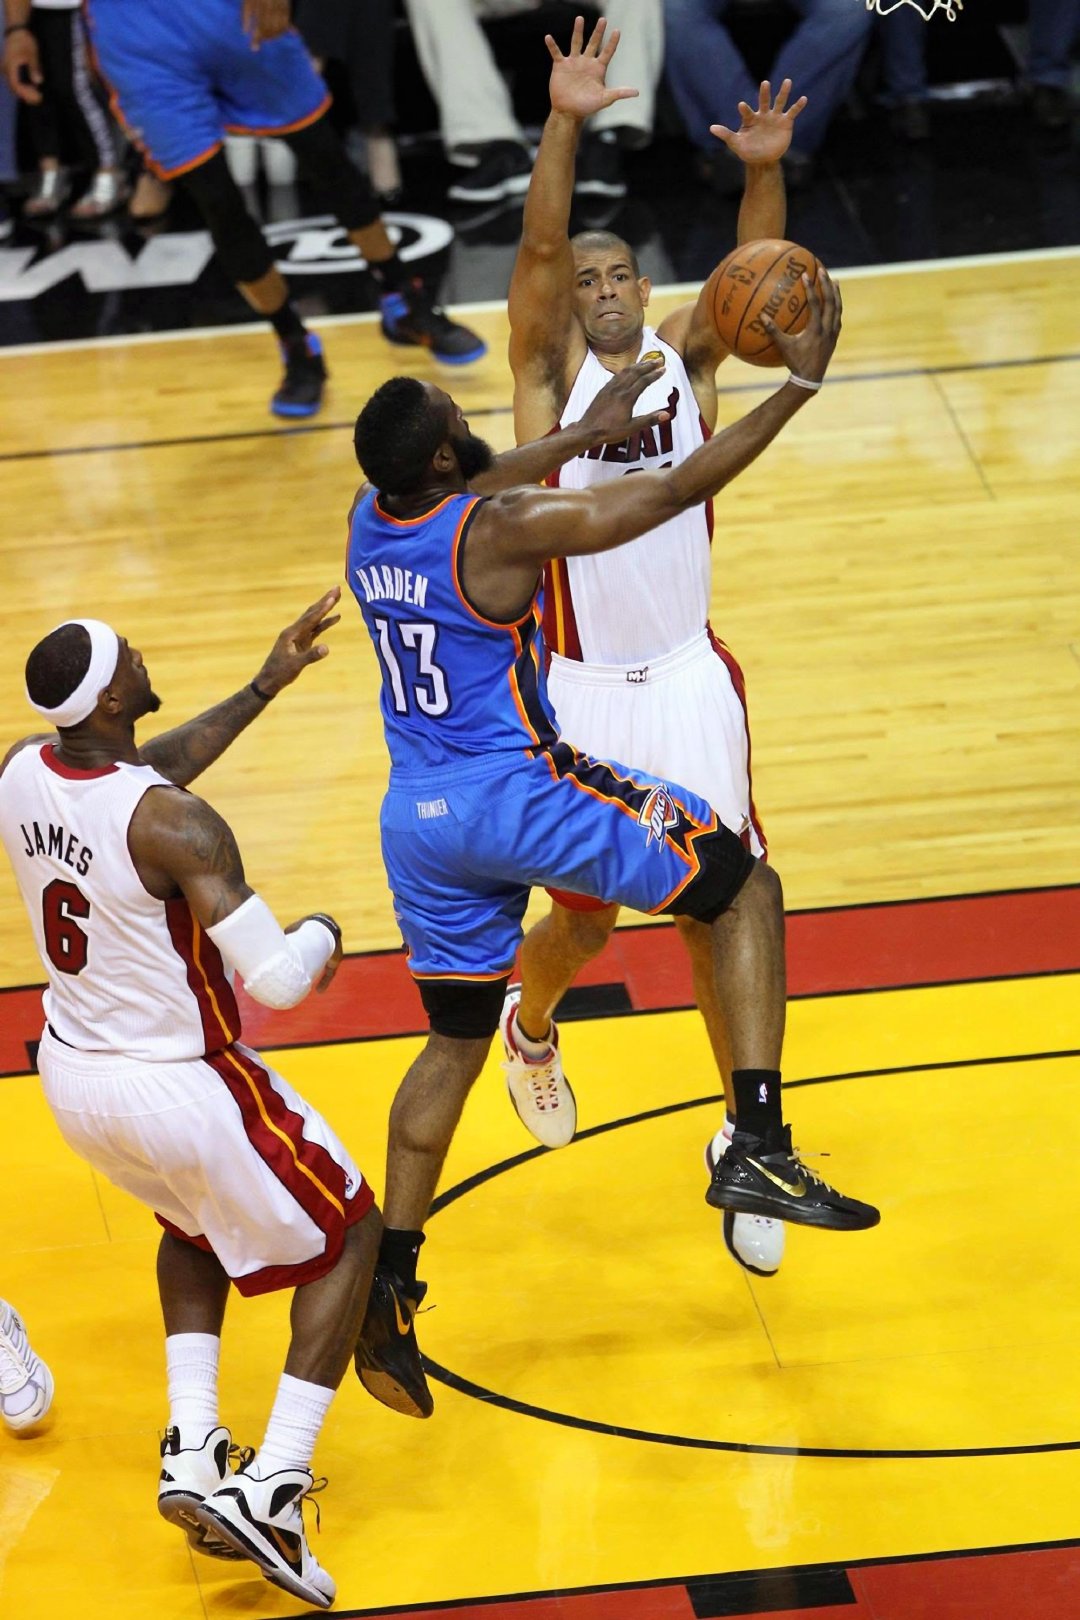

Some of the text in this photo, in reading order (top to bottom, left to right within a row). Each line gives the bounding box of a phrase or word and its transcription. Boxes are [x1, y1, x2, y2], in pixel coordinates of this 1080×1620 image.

[355, 564, 429, 609] HARDEN
[373, 617, 452, 717] 13
[415, 798, 449, 820] THUNDER
[20, 821, 93, 877] JAMES
[41, 877, 91, 977] 6
